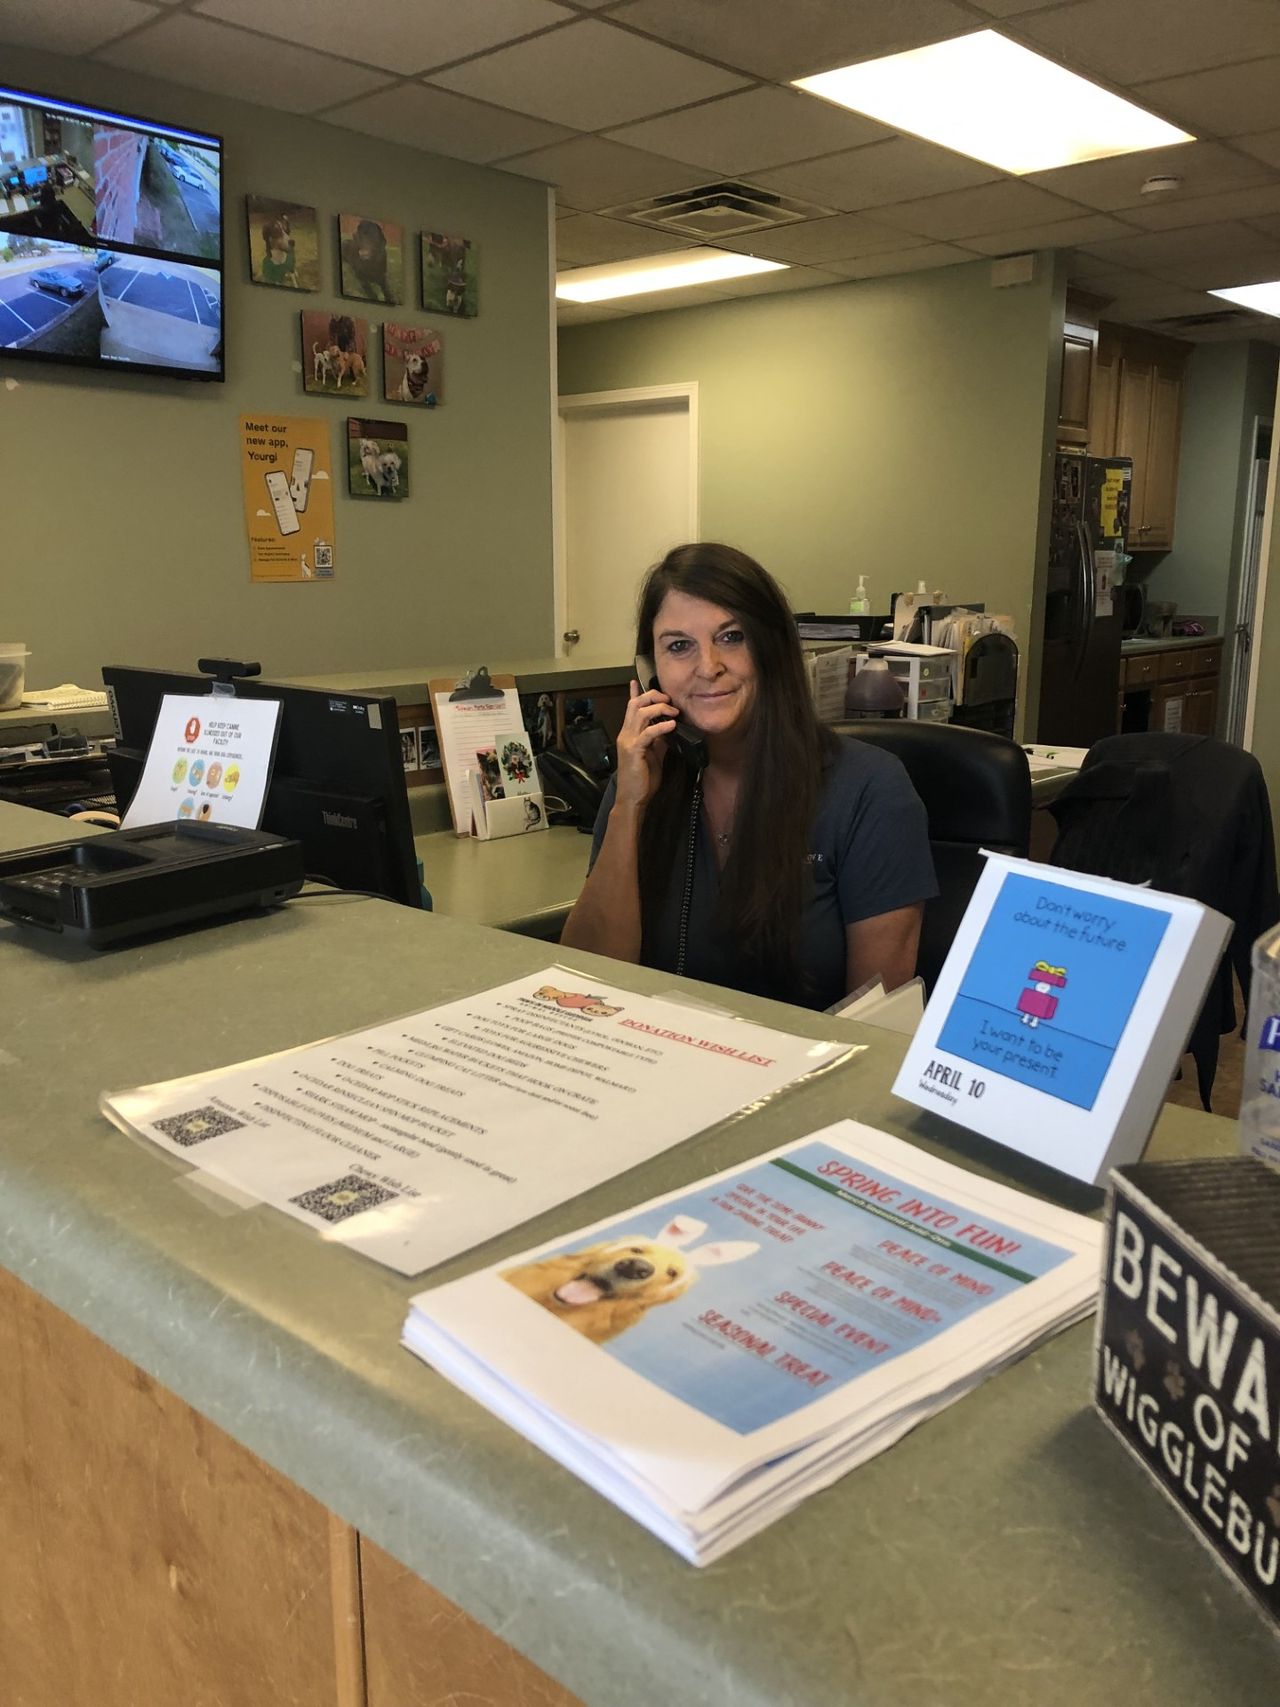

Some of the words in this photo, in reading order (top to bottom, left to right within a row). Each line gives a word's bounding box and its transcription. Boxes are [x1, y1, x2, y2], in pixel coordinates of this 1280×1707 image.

[245, 422, 268, 433] Meet
[271, 426, 287, 434] our
[246, 437, 266, 446] new
[248, 451, 278, 464] Yourgi
[1013, 911, 1051, 928] about
[1053, 920, 1078, 938] the
[1035, 896, 1071, 916] Don't
[1073, 910, 1116, 931] worry
[440, 1025, 460, 1033] GIFT
[457, 1031, 486, 1041] CARDS
[481, 1027, 503, 1036] TOYS
[518, 1039, 566, 1057] AGGRESSIVE
[565, 1055, 609, 1071] CHEWERS
[489, 1020, 510, 1028] TOYS
[525, 1031, 553, 1042] LARGE
[552, 1039, 577, 1049] DOGS
[619, 1019, 693, 1043] DONATION
[690, 1039, 736, 1055] WISH
[730, 1051, 772, 1066] LIST
[972, 1037, 1003, 1055] your
[979, 1019, 989, 1035] I
[989, 1027, 1024, 1046] want
[1027, 1038, 1042, 1054] to
[1043, 1044, 1063, 1062] be
[372, 1048, 390, 1056] PILL
[388, 1054, 425, 1068] POCKETS
[447, 1038, 488, 1054] ELEVATED
[485, 1052, 506, 1060] DOG
[504, 1058, 527, 1067] BEDS
[336, 1060, 355, 1069] DOG
[354, 1067, 384, 1080] TREATS
[378, 1063, 416, 1078] CALMING
[414, 1077, 435, 1086] DOG
[433, 1083, 465, 1096] TREATS
[467, 1057, 505, 1072] BUCKETS
[505, 1070, 528, 1079] THAT
[526, 1077, 551, 1089] HOOK
[552, 1086, 571, 1094] ON
[566, 1091, 598, 1104] CRATE
[923, 1060, 963, 1091] APRIL
[968, 1078, 986, 1099] 10
[918, 1079, 958, 1106] Wednesday
[237, 1110, 255, 1121] Wish
[251, 1118, 270, 1128] List
[258, 1086, 306, 1108] DISPOSABLE
[302, 1106, 336, 1122] GLOVES
[383, 1141, 419, 1158] LARGE)
[328, 1101, 358, 1115] STEAM
[354, 1112, 377, 1122] MOP
[375, 1090, 396, 1099] MOP
[393, 1097, 420, 1109] STICK
[418, 1106, 486, 1134] REPLACEMENTS
[399, 1114, 420, 1123] MOP
[417, 1121, 455, 1137] BUCKET
[260, 1105, 314, 1130] DISINFECTING
[311, 1127, 341, 1143] FLOOR
[338, 1140, 380, 1160] CLEANER
[379, 1175, 402, 1188] Wish
[398, 1185, 421, 1197] List
[736, 1183, 755, 1194] GIVE
[756, 1194, 772, 1202] THE
[768, 1213, 789, 1226] YOUR
[818, 1161, 898, 1202] SPRING
[897, 1199, 958, 1228] INTO
[955, 1223, 1019, 1254] FUN!
[837, 1189, 868, 1205] March
[865, 1203, 910, 1225] Seasonal
[823, 1262, 870, 1289] PEACE
[870, 1286, 895, 1299] OF
[880, 1240, 927, 1265] PEACE
[927, 1263, 950, 1276] OF
[949, 1272, 992, 1296] MIND
[774, 1291, 832, 1326] SPECIAL
[834, 1323, 889, 1354] EVENT
[1112, 1211, 1280, 1455] BEWA
[700, 1310, 772, 1355] SEASONAL
[775, 1352, 830, 1385] TREAT
[1193, 1393, 1252, 1472] OF
